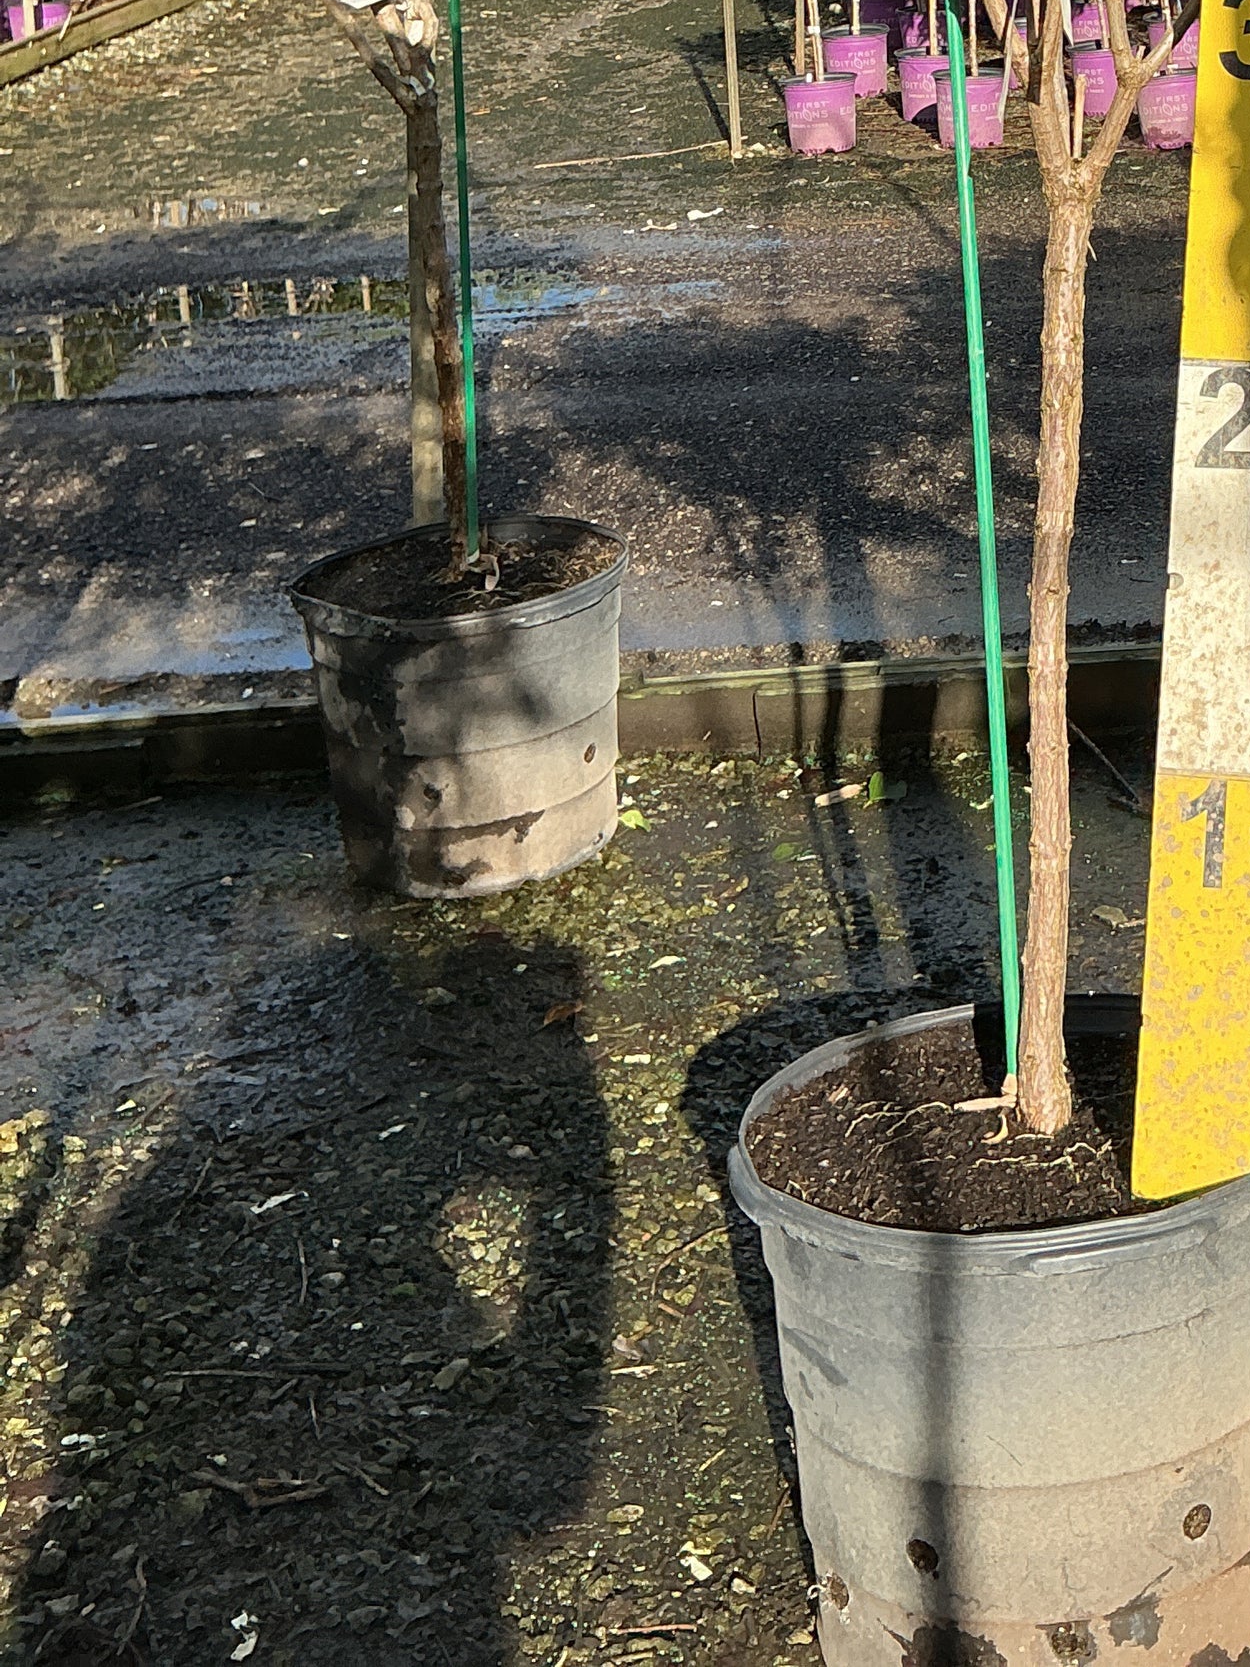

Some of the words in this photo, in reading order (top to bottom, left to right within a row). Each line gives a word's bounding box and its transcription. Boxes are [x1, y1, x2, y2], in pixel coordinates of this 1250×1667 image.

[848, 49, 876, 58] FIRST
[829, 57, 876, 69] EDITIONS
[1156, 94, 1187, 103] FIRST
[796, 100, 830, 108] FIRST
[1143, 103, 1189, 116] DITIONS
[1180, 779, 1227, 888] 1
